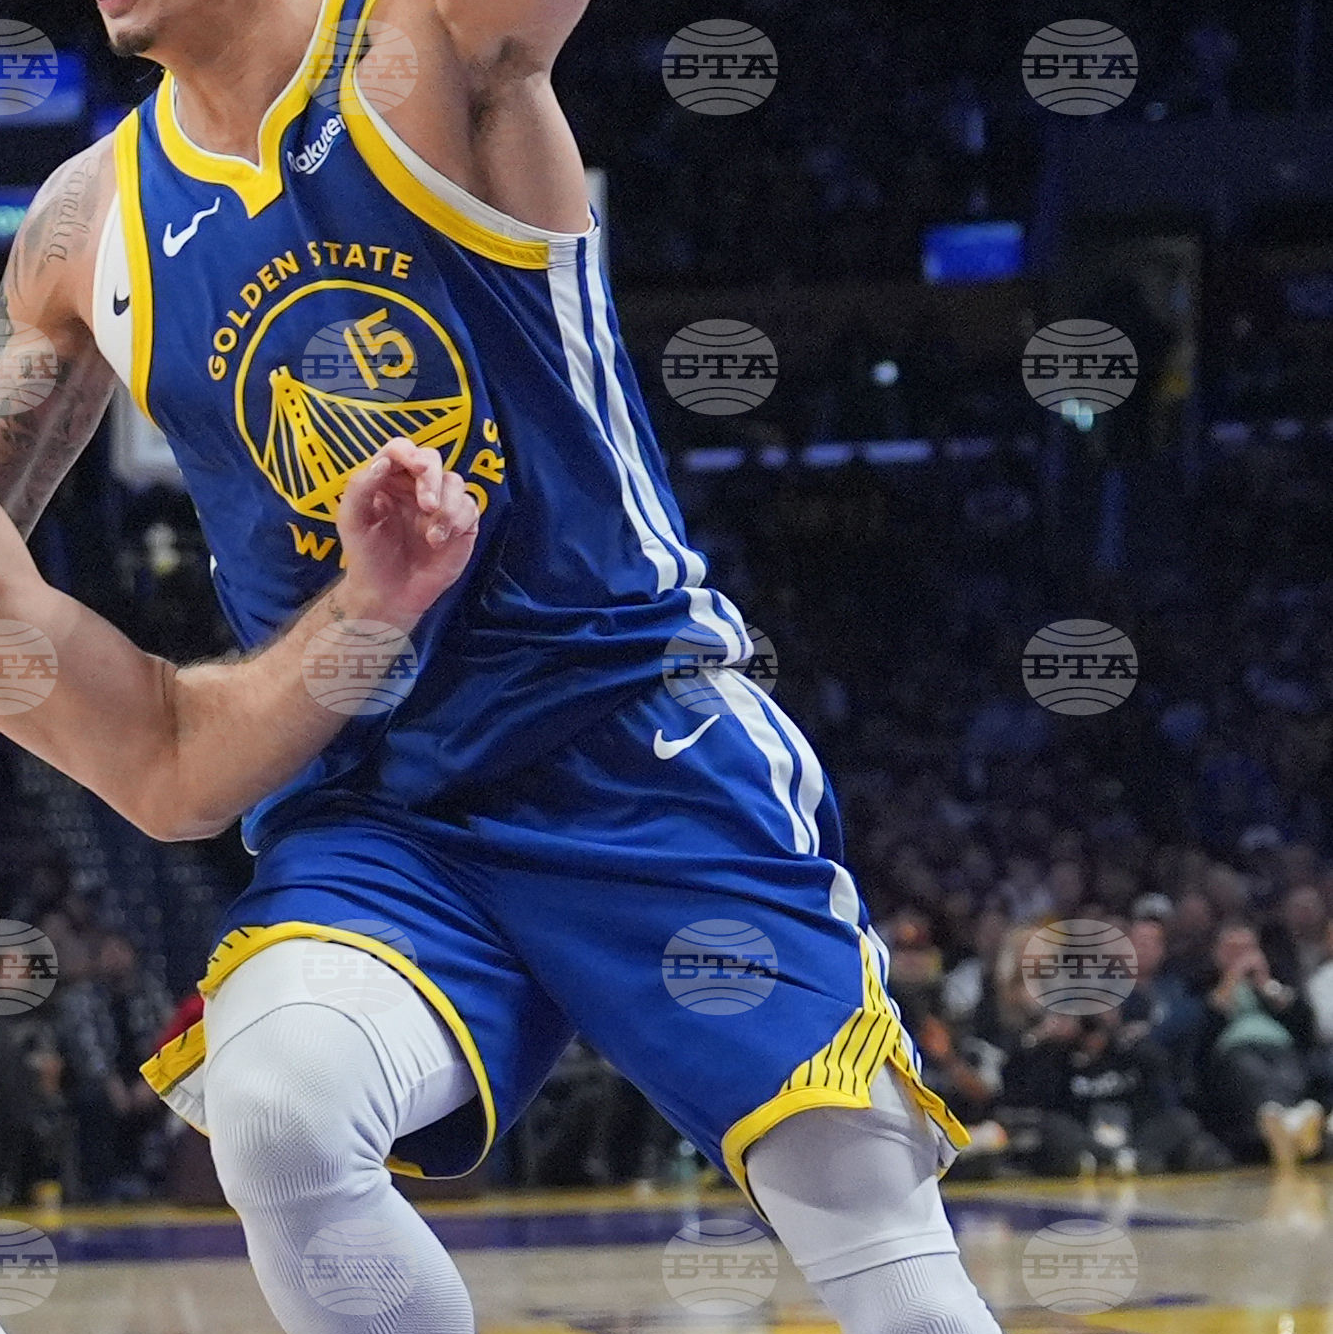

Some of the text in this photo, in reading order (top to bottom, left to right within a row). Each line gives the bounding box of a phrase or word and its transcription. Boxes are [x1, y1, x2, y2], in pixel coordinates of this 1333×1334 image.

[208, 241, 413, 381] GOLDEN STATE
[343, 308, 415, 390] 15
